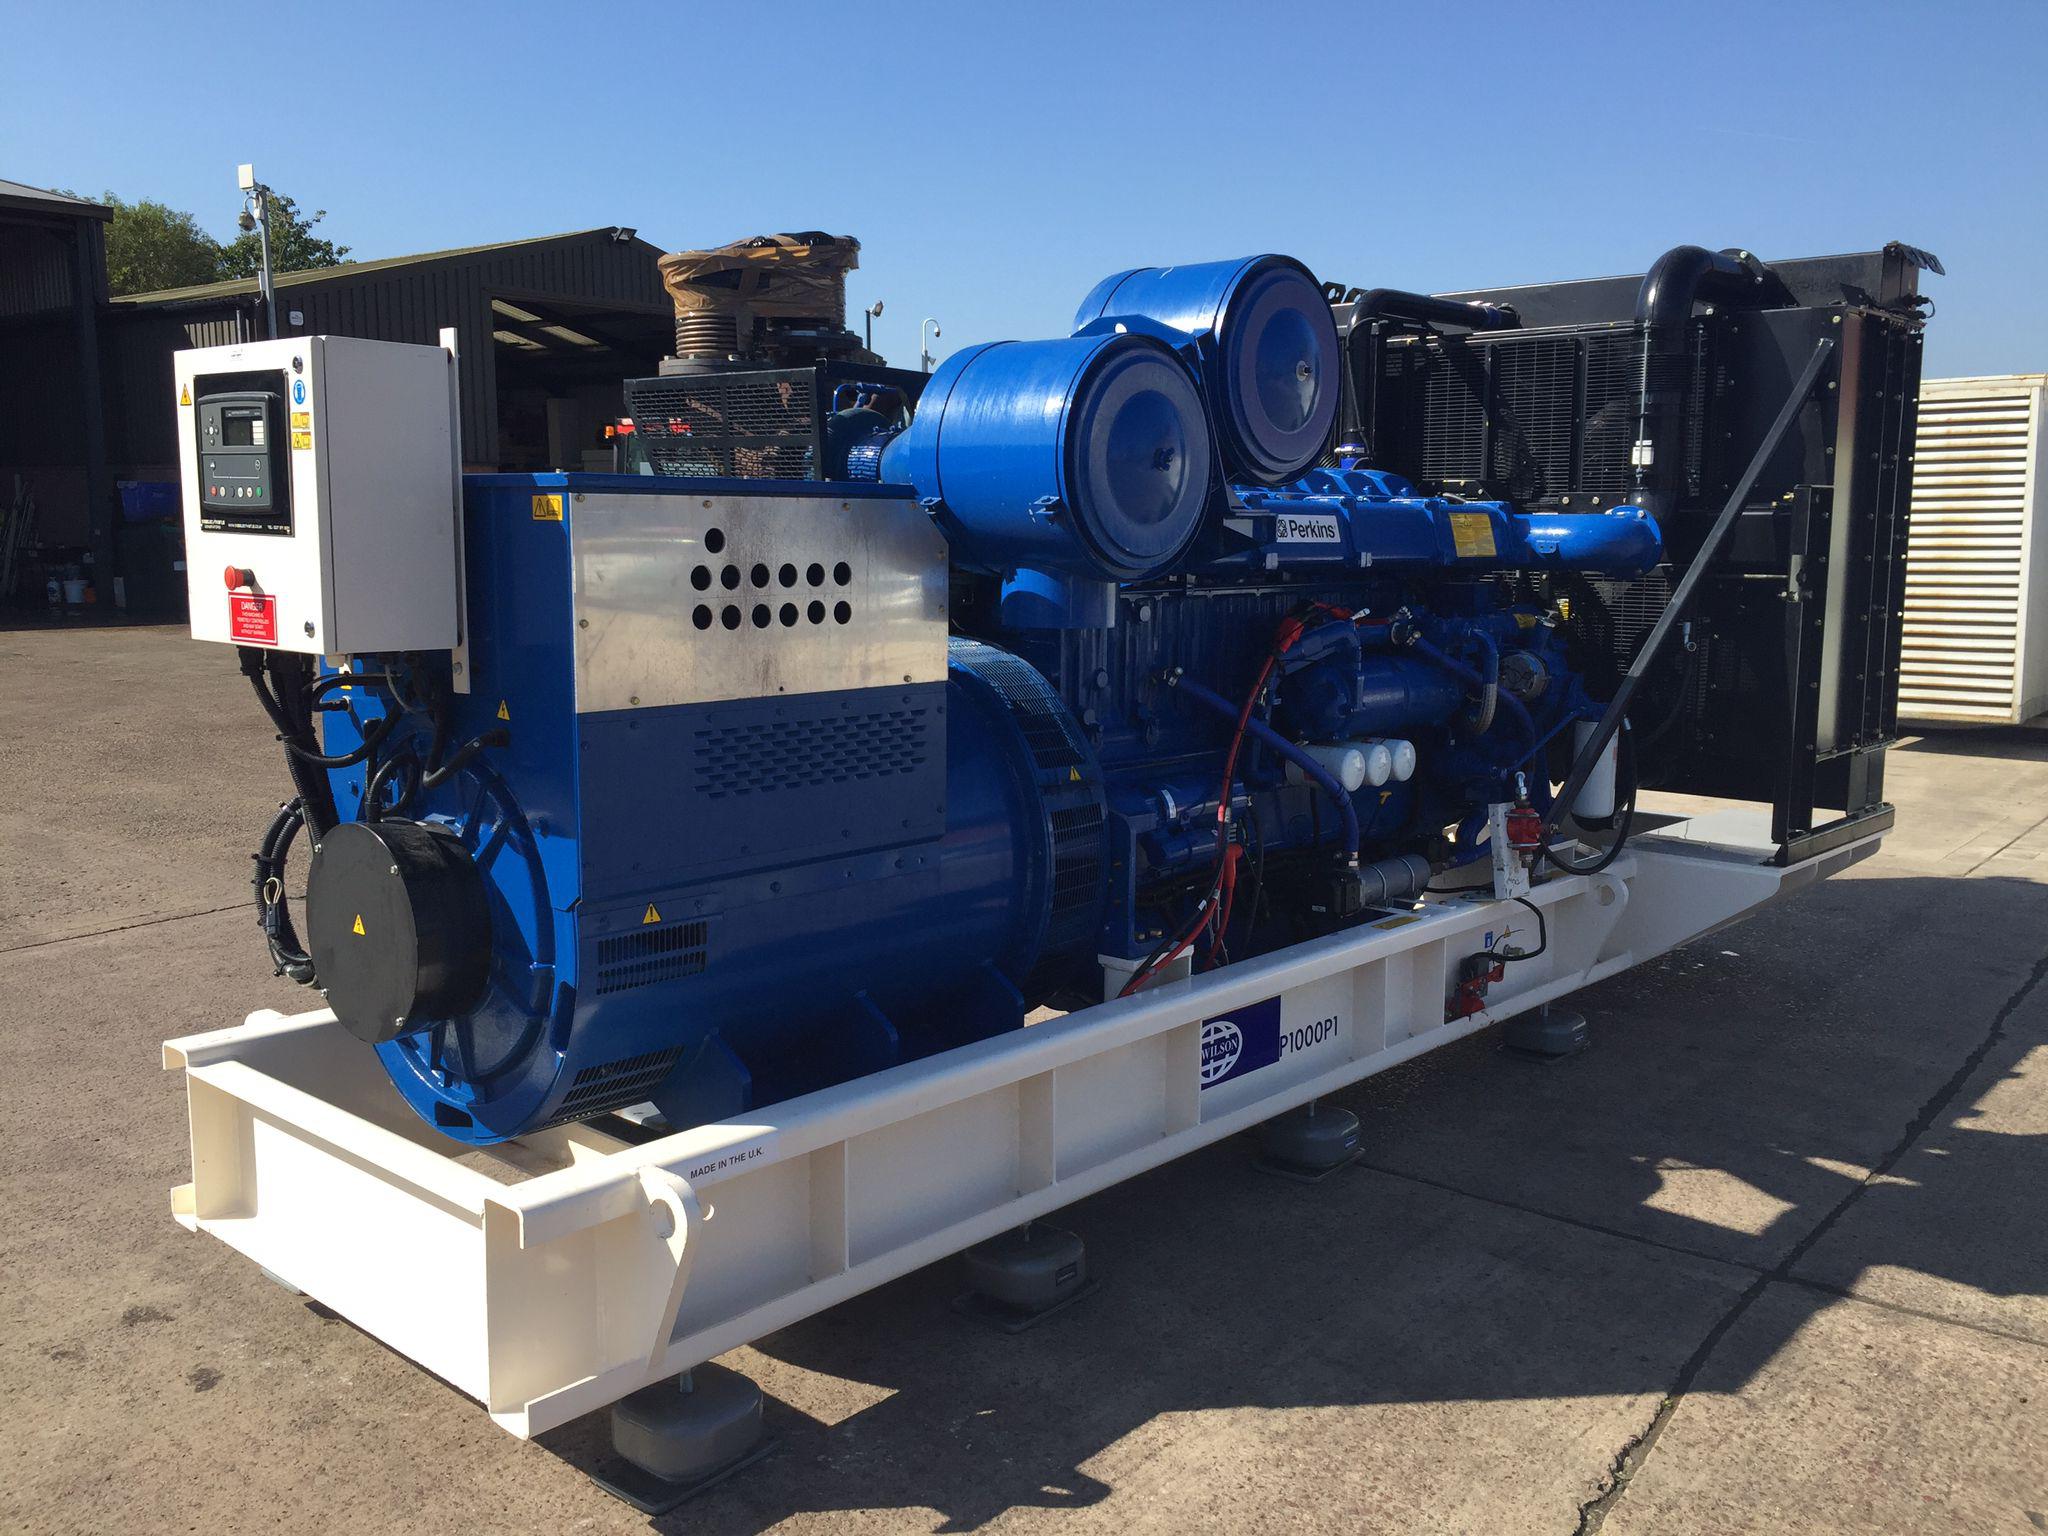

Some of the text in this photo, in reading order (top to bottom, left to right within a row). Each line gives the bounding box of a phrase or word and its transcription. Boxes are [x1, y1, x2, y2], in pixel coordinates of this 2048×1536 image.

[1289, 520, 1336, 538] Perkins
[241, 601, 264, 611] DANGER
[1280, 1016, 1338, 1058] P1000P1
[690, 1147, 765, 1179] MADE IN THE U.K.
